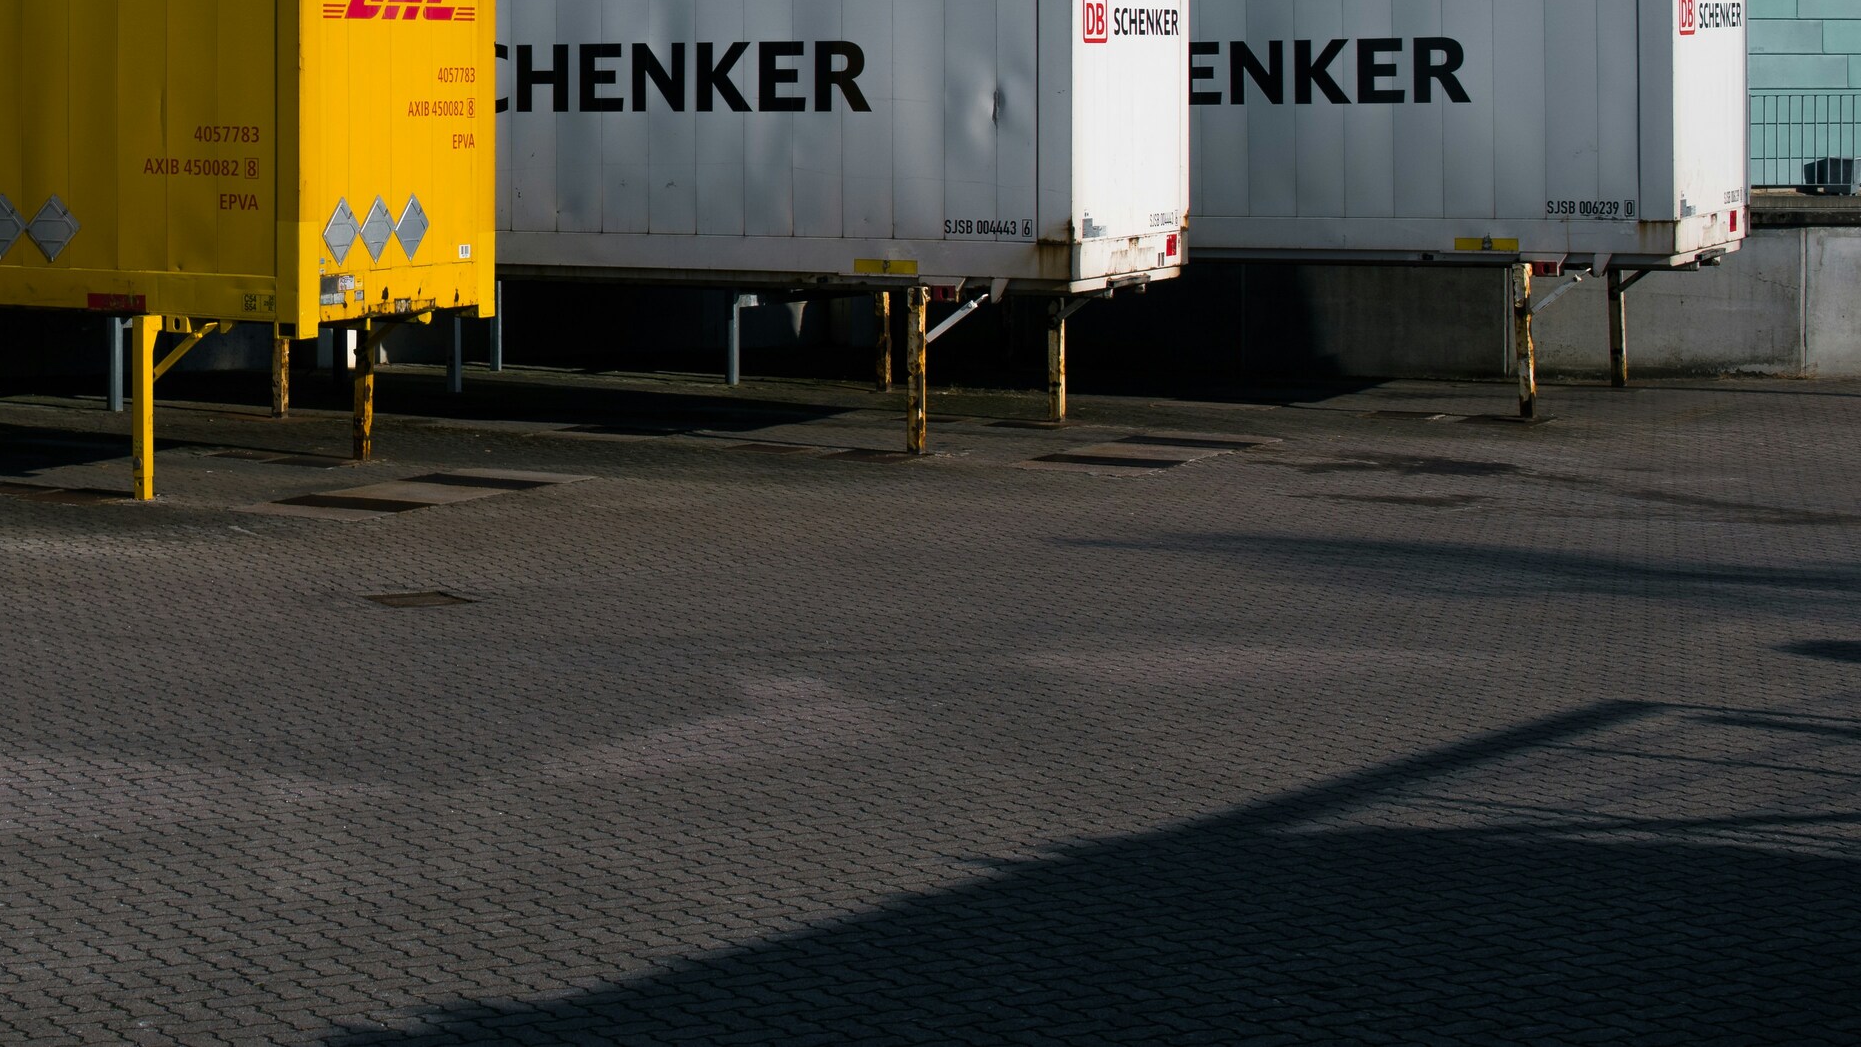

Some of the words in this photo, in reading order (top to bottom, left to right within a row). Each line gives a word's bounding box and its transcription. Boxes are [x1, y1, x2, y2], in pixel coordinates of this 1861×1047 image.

[1113, 7, 1179, 36] SCHENKER
[1699, 2, 1742, 29] SCHENKER
[438, 67, 476, 83] 4057783
[495, 40, 872, 113] HENKER
[1188, 36, 1472, 105] ENKER
[408, 101, 430, 117] AXIB
[431, 100, 464, 117] 450082
[194, 125, 260, 143] 4057783
[452, 133, 476, 150] EPVA
[143, 158, 180, 174] AXIB
[184, 159, 239, 177] 450082
[220, 193, 259, 211] EPVA
[1547, 200, 1576, 215] SJSB
[1579, 200, 1619, 215] 006239
[944, 219, 973, 235] SJSB
[976, 219, 1017, 236] 004443
